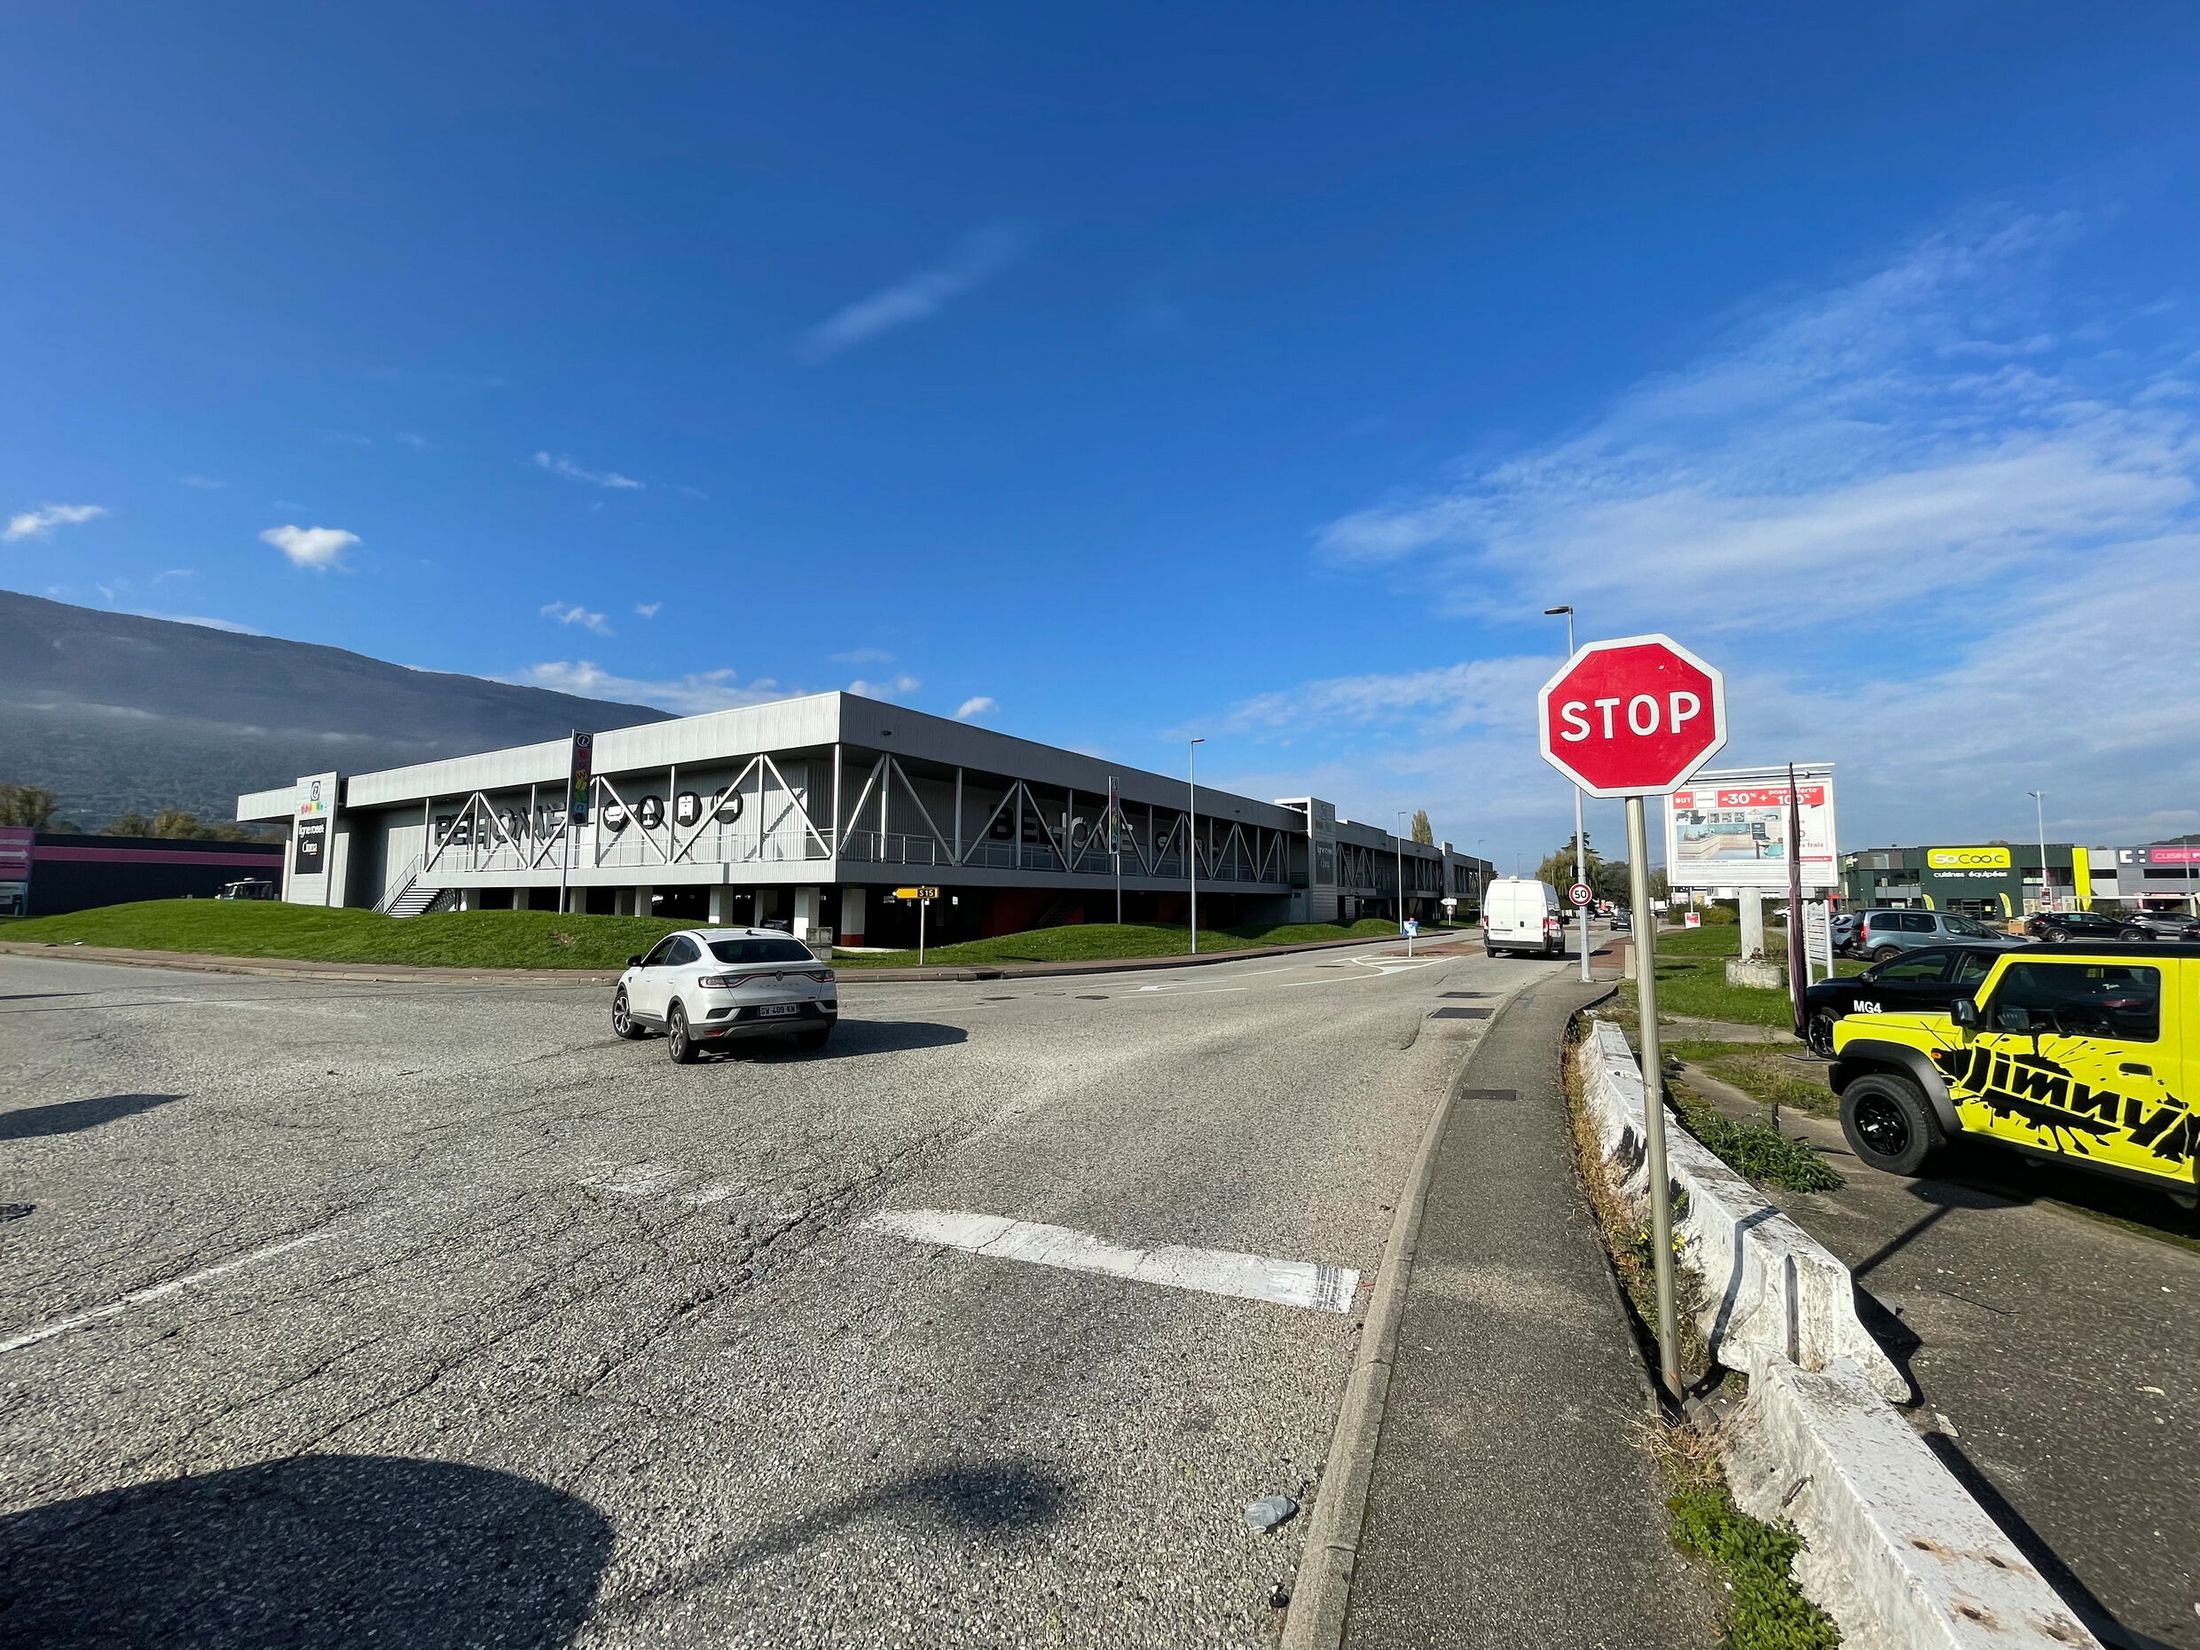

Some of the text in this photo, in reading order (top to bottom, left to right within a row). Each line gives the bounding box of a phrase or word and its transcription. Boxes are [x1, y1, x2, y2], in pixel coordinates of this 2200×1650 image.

[1560, 691, 1701, 742] STOP
[1721, 791, 1757, 805] -30%
[1968, 869, 2008, 879] équipées
[919, 889, 934, 897] S15
[1574, 889, 1587, 898] 50
[1853, 999, 1883, 1014] MG4
